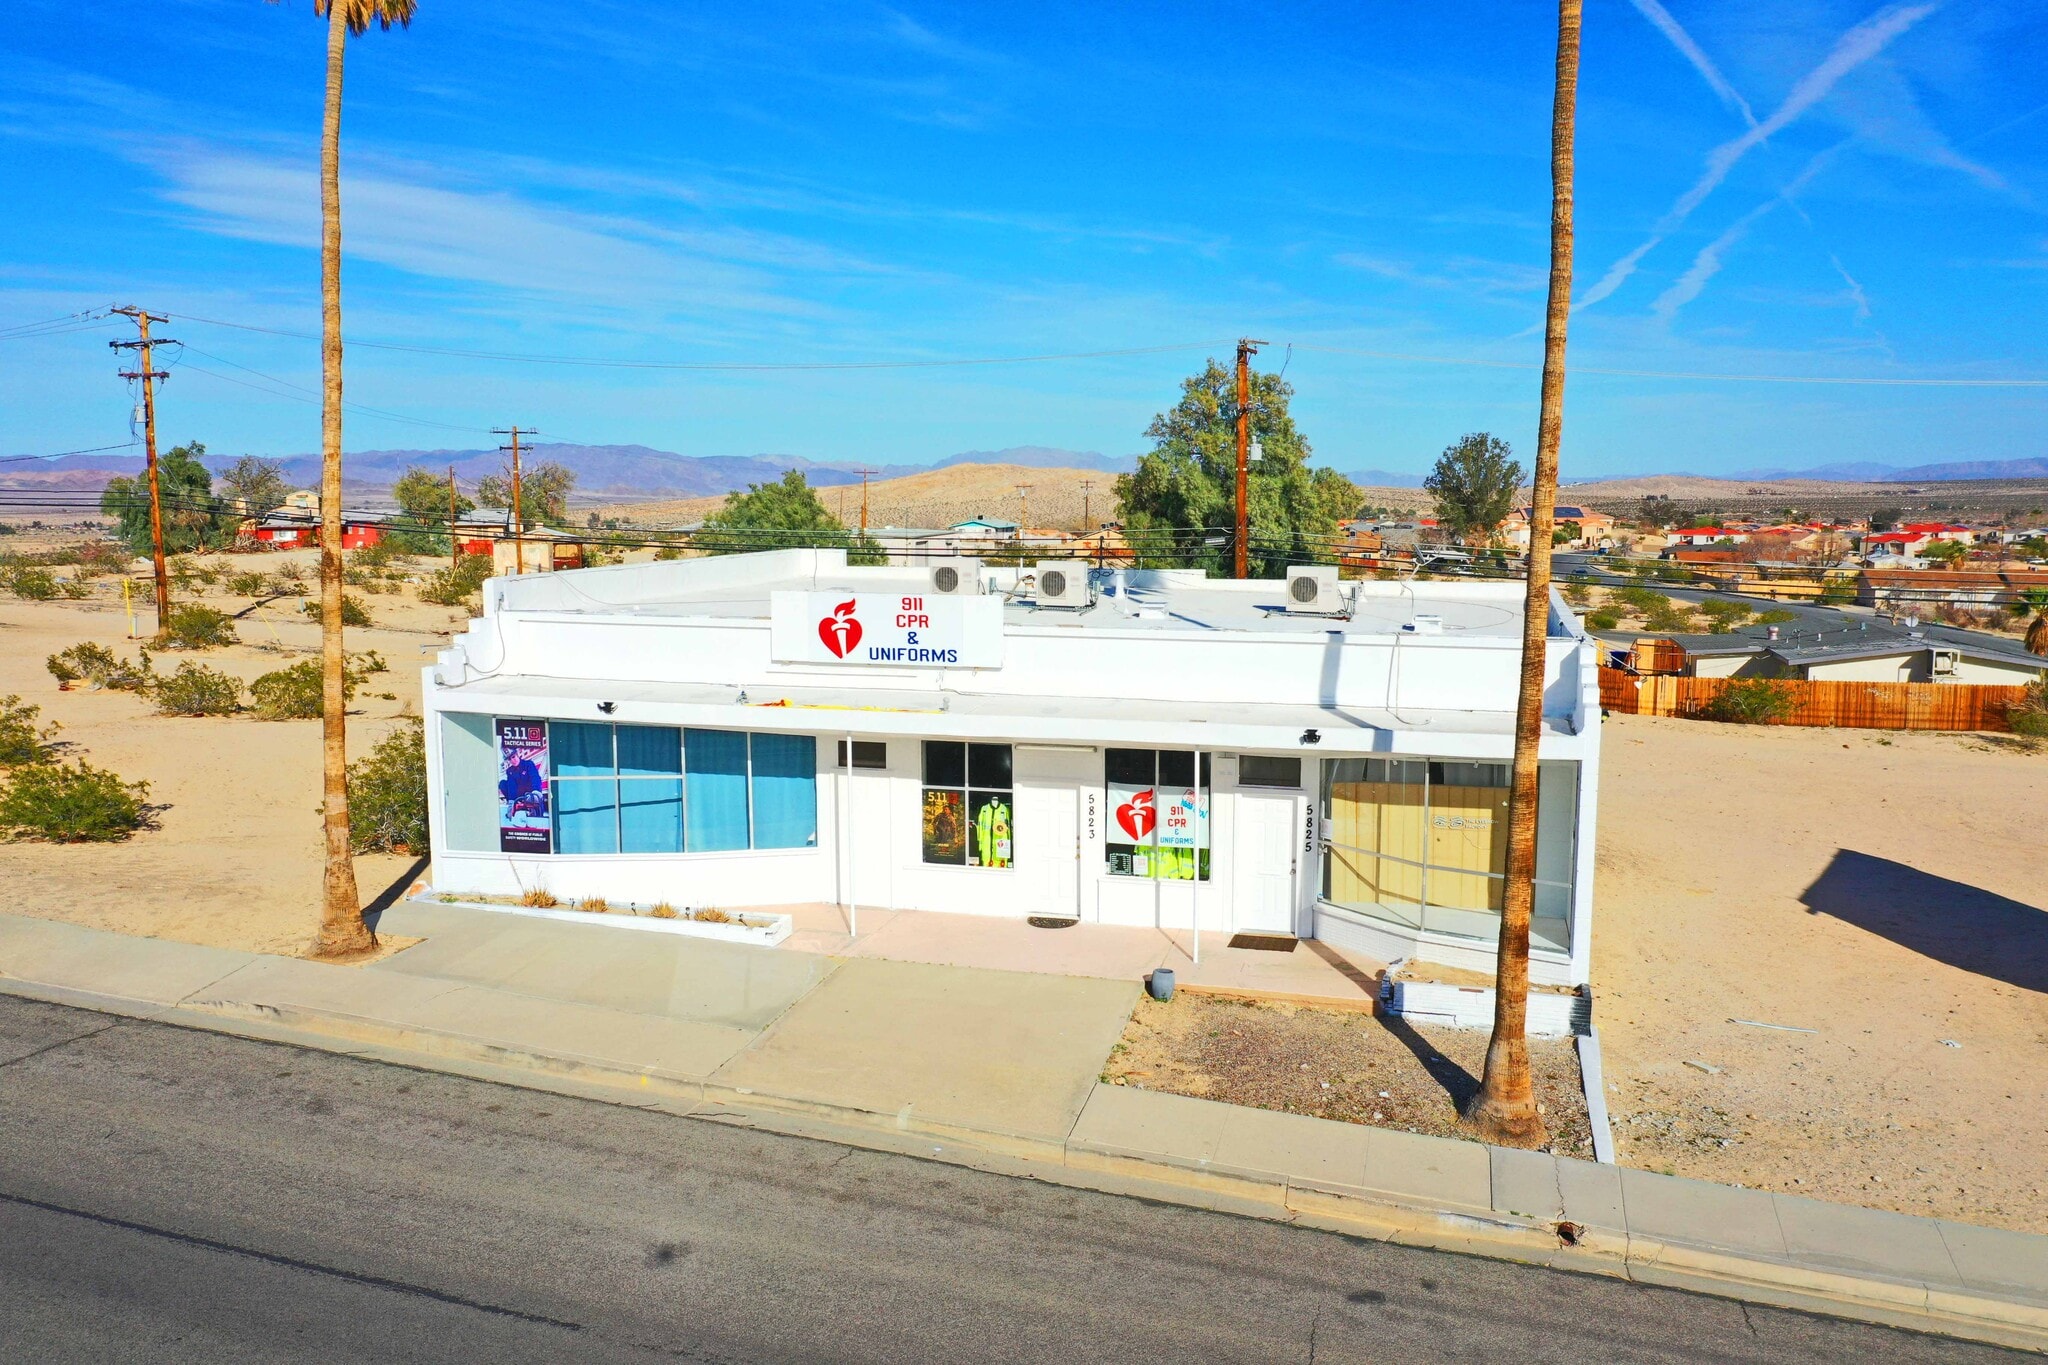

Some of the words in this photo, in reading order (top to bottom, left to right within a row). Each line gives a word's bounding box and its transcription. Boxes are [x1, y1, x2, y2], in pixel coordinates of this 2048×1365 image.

[902, 597, 923, 611] 911
[896, 614, 929, 628] CPR
[907, 631, 919, 645] &
[869, 647, 958, 663] UNIFORMS
[503, 727, 528, 740] 5.11
[928, 791, 947, 803] 5.11
[1088, 793, 1096, 839] 5823
[1170, 806, 1184, 816] 911
[1167, 818, 1187, 828] CPR
[1305, 804, 1314, 852] 5825
[1160, 837, 1194, 845] UNIFORMS
